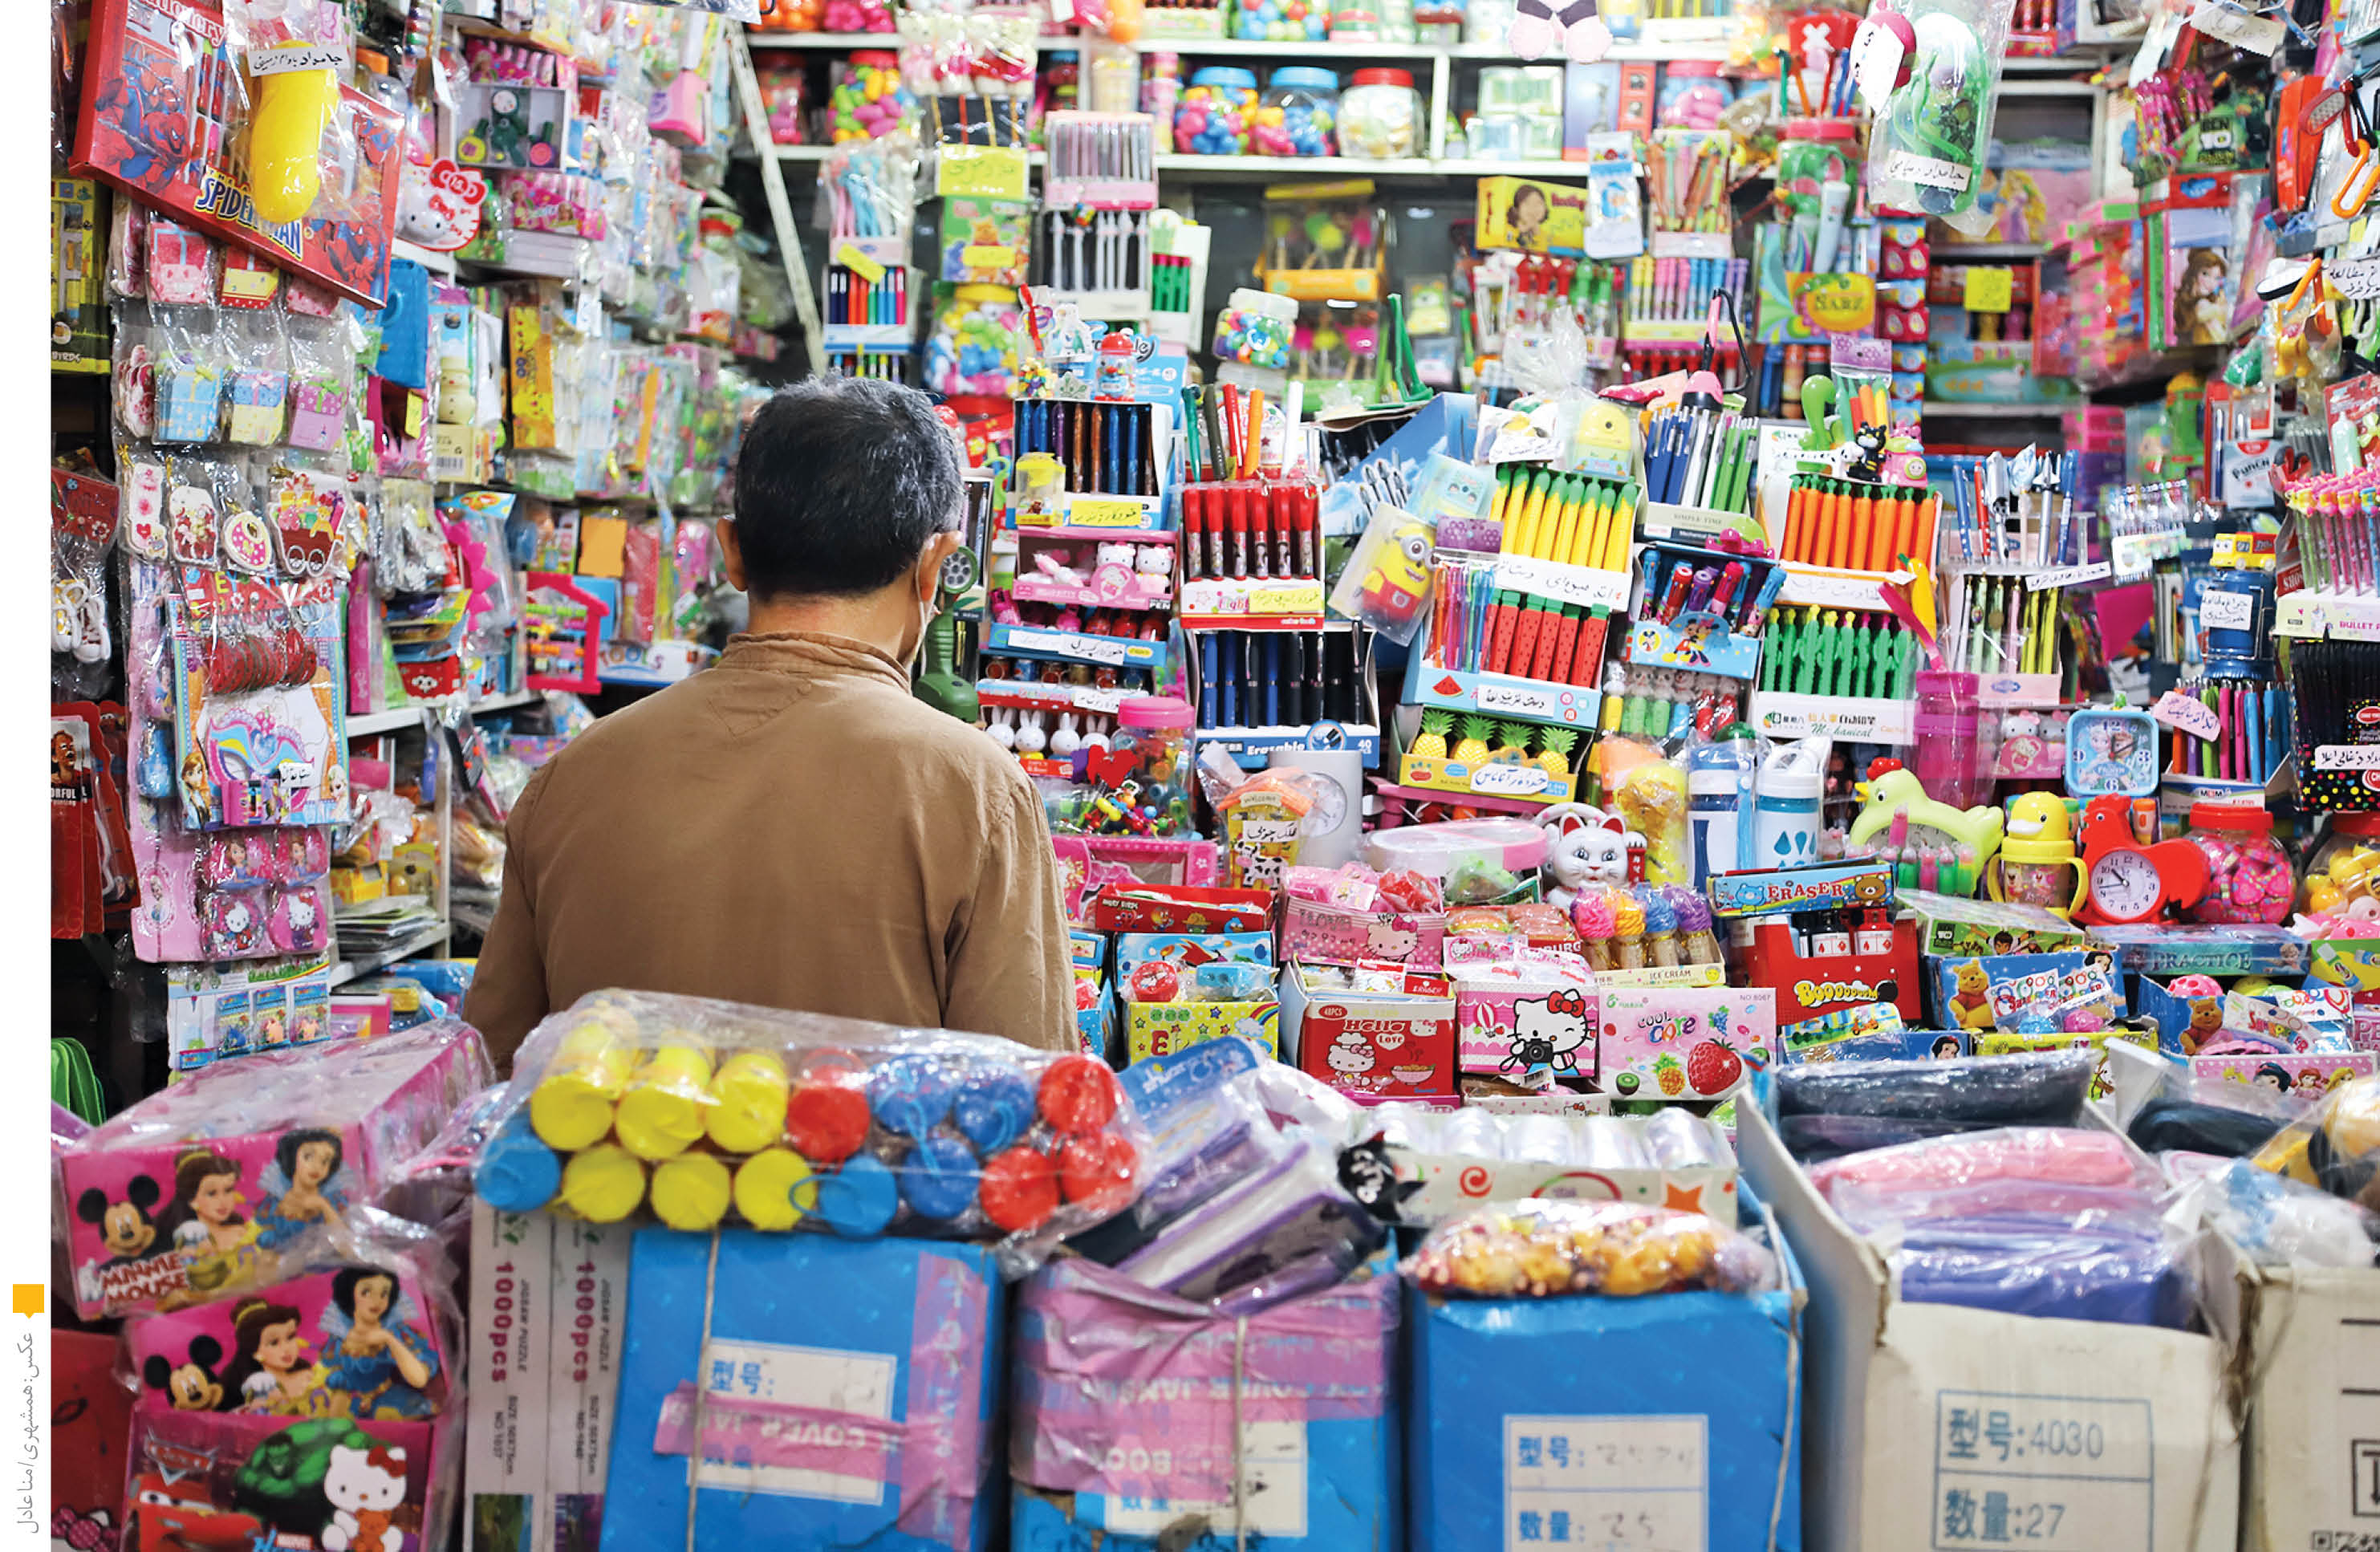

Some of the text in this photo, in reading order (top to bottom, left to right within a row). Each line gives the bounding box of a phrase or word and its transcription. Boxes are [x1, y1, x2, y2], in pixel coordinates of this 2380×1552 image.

[1767, 881, 1844, 900] ERASER
[2152, 950, 2252, 972] PRACTICE
[1343, 1019, 1407, 1033] Hello
[1378, 1034, 1403, 1044] Love
[102, 1251, 183, 1290] MINNIE
[107, 1271, 190, 1302] MOUSE
[490, 1262, 515, 1383] 1000pcs
[574, 1262, 596, 1383] 1000pcs
[517, 1327, 529, 1372] PUZZLE
